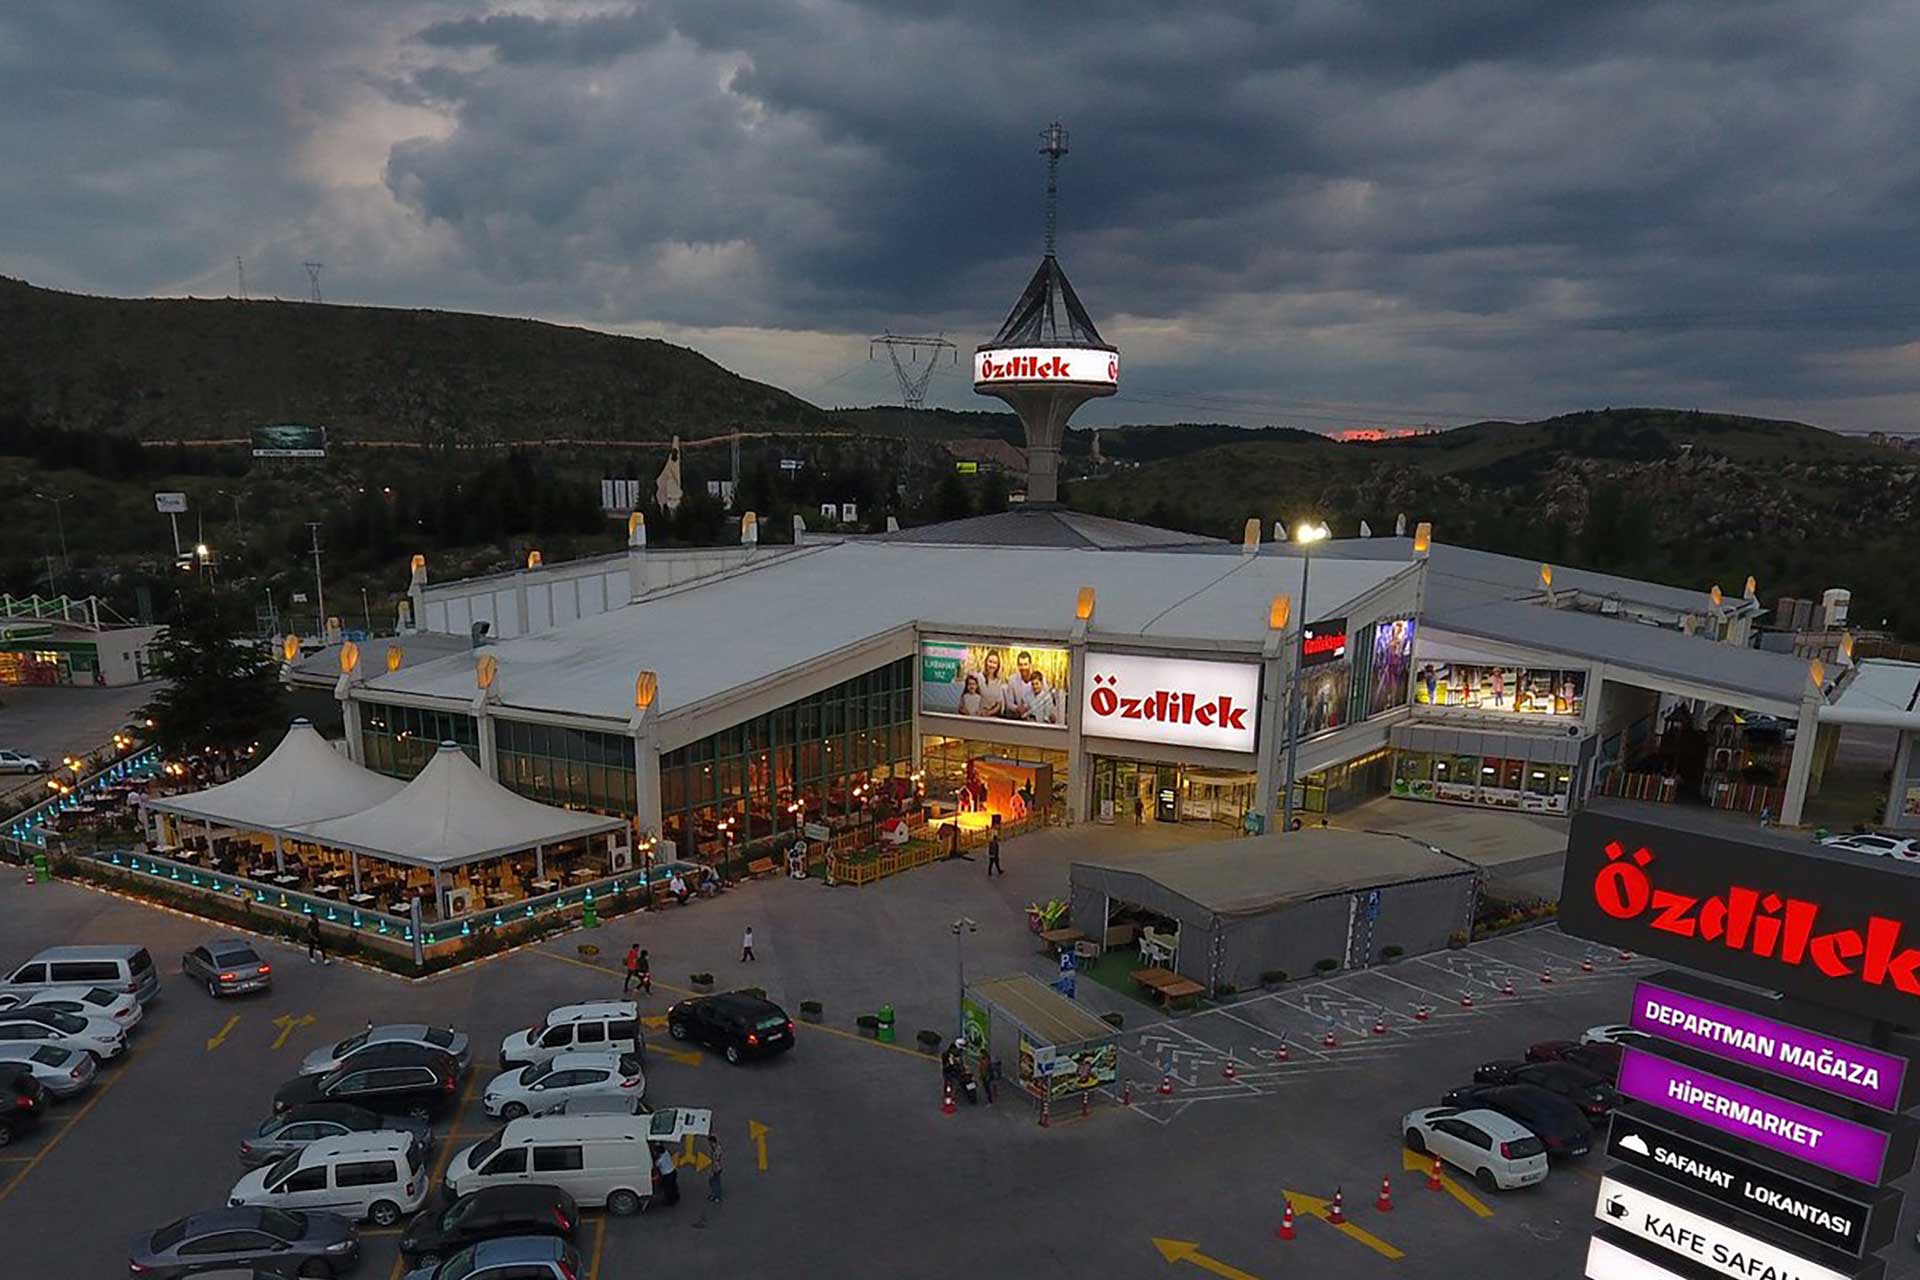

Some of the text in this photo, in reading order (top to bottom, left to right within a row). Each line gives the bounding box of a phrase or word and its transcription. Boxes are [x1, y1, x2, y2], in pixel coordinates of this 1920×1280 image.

[982, 353, 1071, 379] Özdilek
[1090, 674, 1248, 730] Özdilek
[1594, 841, 1920, 996] Özdilek
[1645, 1001, 1879, 1090] DEPARTMAN MAĞAZA
[1668, 1079, 1823, 1149] HİPERMARKET
[1654, 1147, 1851, 1237] SAFAHAT LOKANTASI
[1644, 1213, 1706, 1255] KAFE
